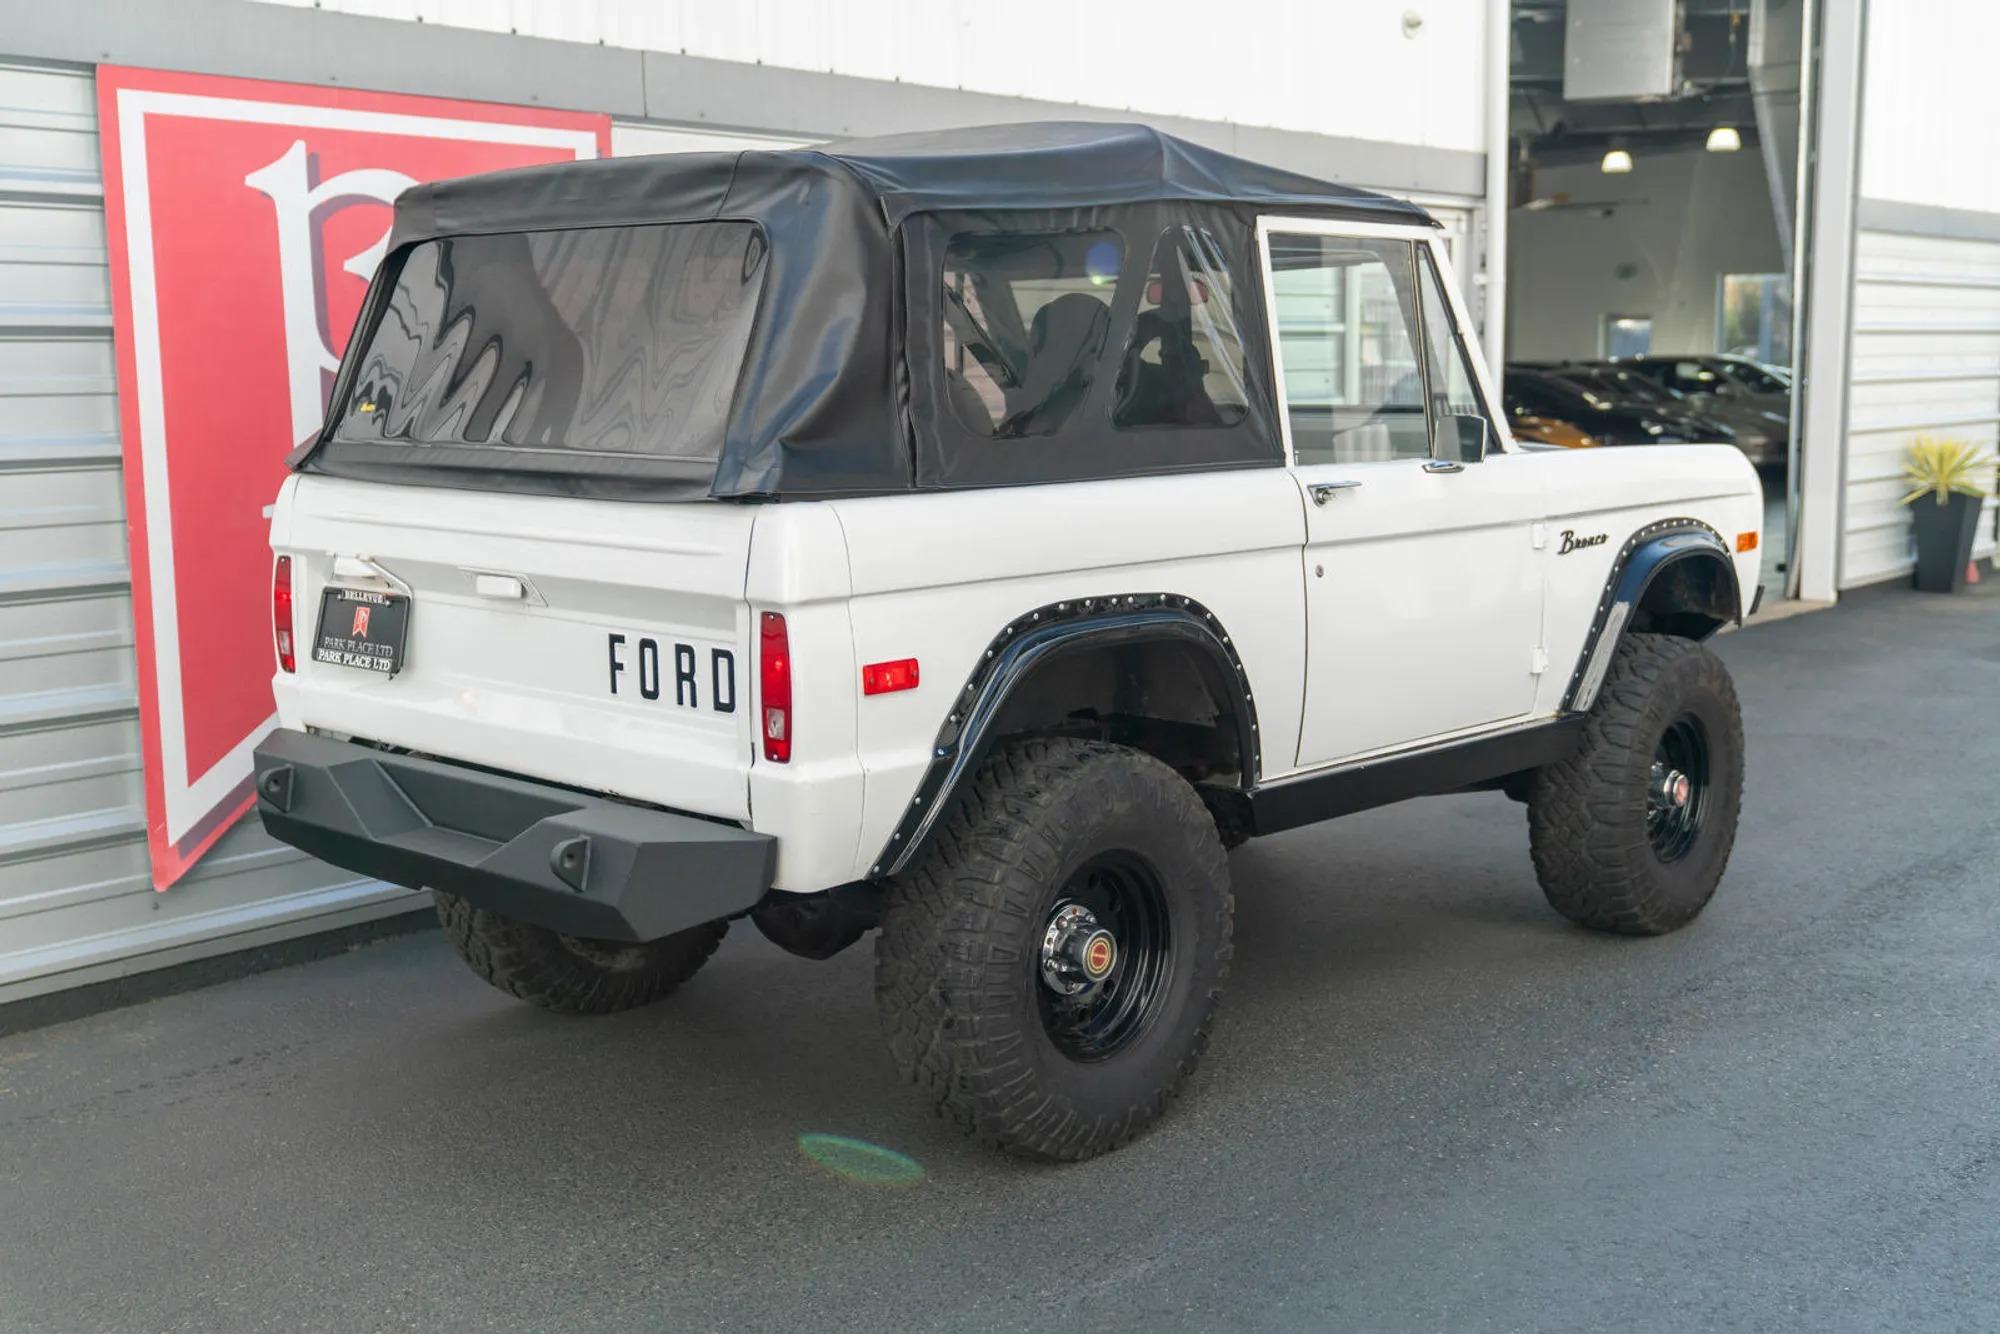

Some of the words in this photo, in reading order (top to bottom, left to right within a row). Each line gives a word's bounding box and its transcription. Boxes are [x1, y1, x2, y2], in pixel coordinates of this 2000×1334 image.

[1557, 530, 1609, 555] Bronco
[344, 590, 384, 604] BELLEVUE
[324, 636, 346, 650] PARK
[347, 640, 374, 654] PLACE
[375, 645, 393, 657] LTD
[318, 649, 342, 663] PARK
[343, 653, 372, 668] PLACE
[372, 657, 392, 671] LTD
[608, 633, 736, 713] FORD
